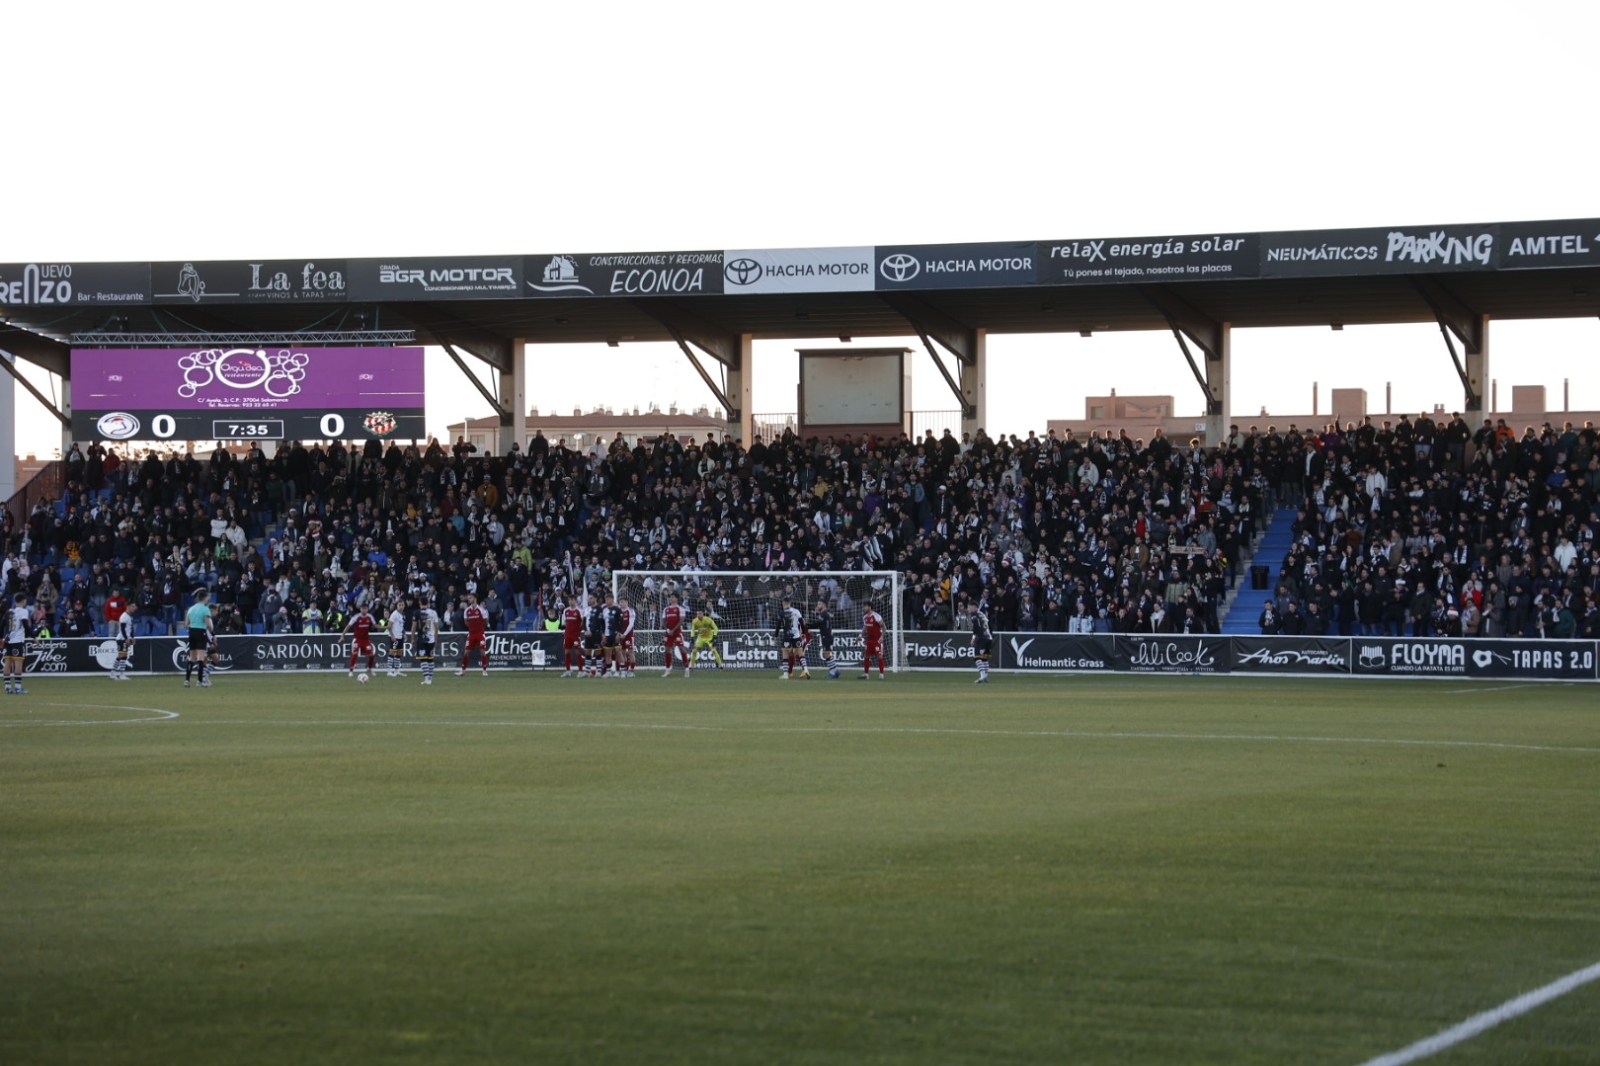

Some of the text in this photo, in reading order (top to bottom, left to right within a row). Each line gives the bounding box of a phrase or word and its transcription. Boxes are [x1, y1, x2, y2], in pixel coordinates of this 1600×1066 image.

[1109, 238, 1184, 258] energía
[1190, 236, 1245, 253] solar
[1267, 230, 1493, 265] NEUMÁTICOS PARKING
[1508, 234, 1590, 257] AMTEL
[590, 253, 723, 267] CONSTRUCCIONES Y REFORMAS
[925, 257, 1033, 274] HACHA MOTOR
[248, 262, 346, 291] La fea
[430, 267, 517, 285] MOTOR
[766, 262, 870, 278] HACHA MOTOR
[1063, 264, 1232, 279] Tú pones el tejado, nosotros las placas
[610, 267, 703, 294] ECONOA
[78, 293, 91, 301] Bar
[97, 292, 144, 301] Restaurante
[267, 291, 291, 299] VINOS
[151, 414, 177, 438] 0
[228, 424, 269, 436] 7:35
[319, 413, 345, 437] 0
[256, 639, 323, 659] SARDÓN
[331, 643, 351, 658] DE
[640, 645, 666, 653] MOTO
[723, 640, 778, 661] Lastra
[905, 642, 976, 657] Flexi ca
[1166, 639, 1214, 666] Cook
[1391, 643, 1466, 666] FLOYMA
[41, 661, 67, 671] .com
[1025, 657, 1105, 668] Helmantic Grass
[1512, 649, 1593, 669] TAPAS 2.0
